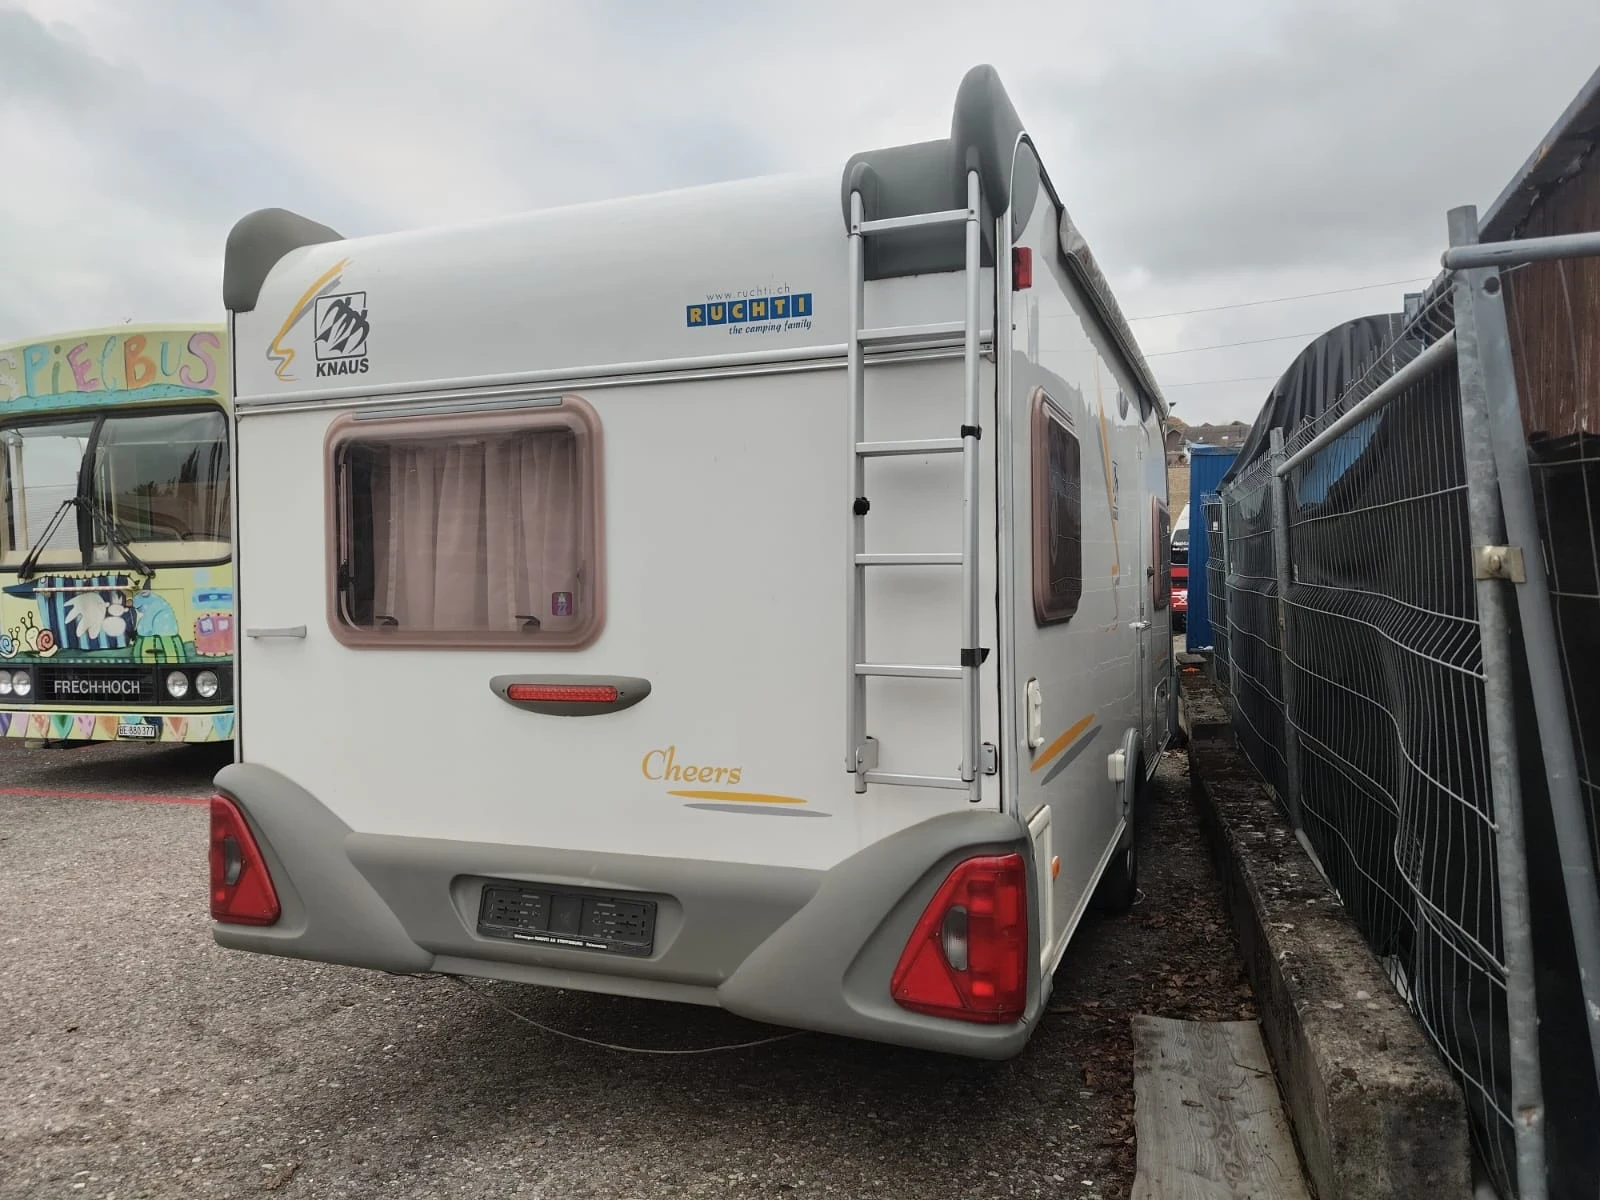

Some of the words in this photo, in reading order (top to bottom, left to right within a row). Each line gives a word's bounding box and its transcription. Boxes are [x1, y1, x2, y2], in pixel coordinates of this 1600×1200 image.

[706, 282, 790, 301] www.ruchti.ch
[690, 297, 805, 323] RUCHTI
[729, 325, 743, 335] the
[745, 322, 782, 335] camping
[784, 319, 812, 332] family
[316, 358, 369, 378] KNAUS
[54, 680, 140, 694] FRECH-HOCH
[641, 744, 742, 785] Cheers
